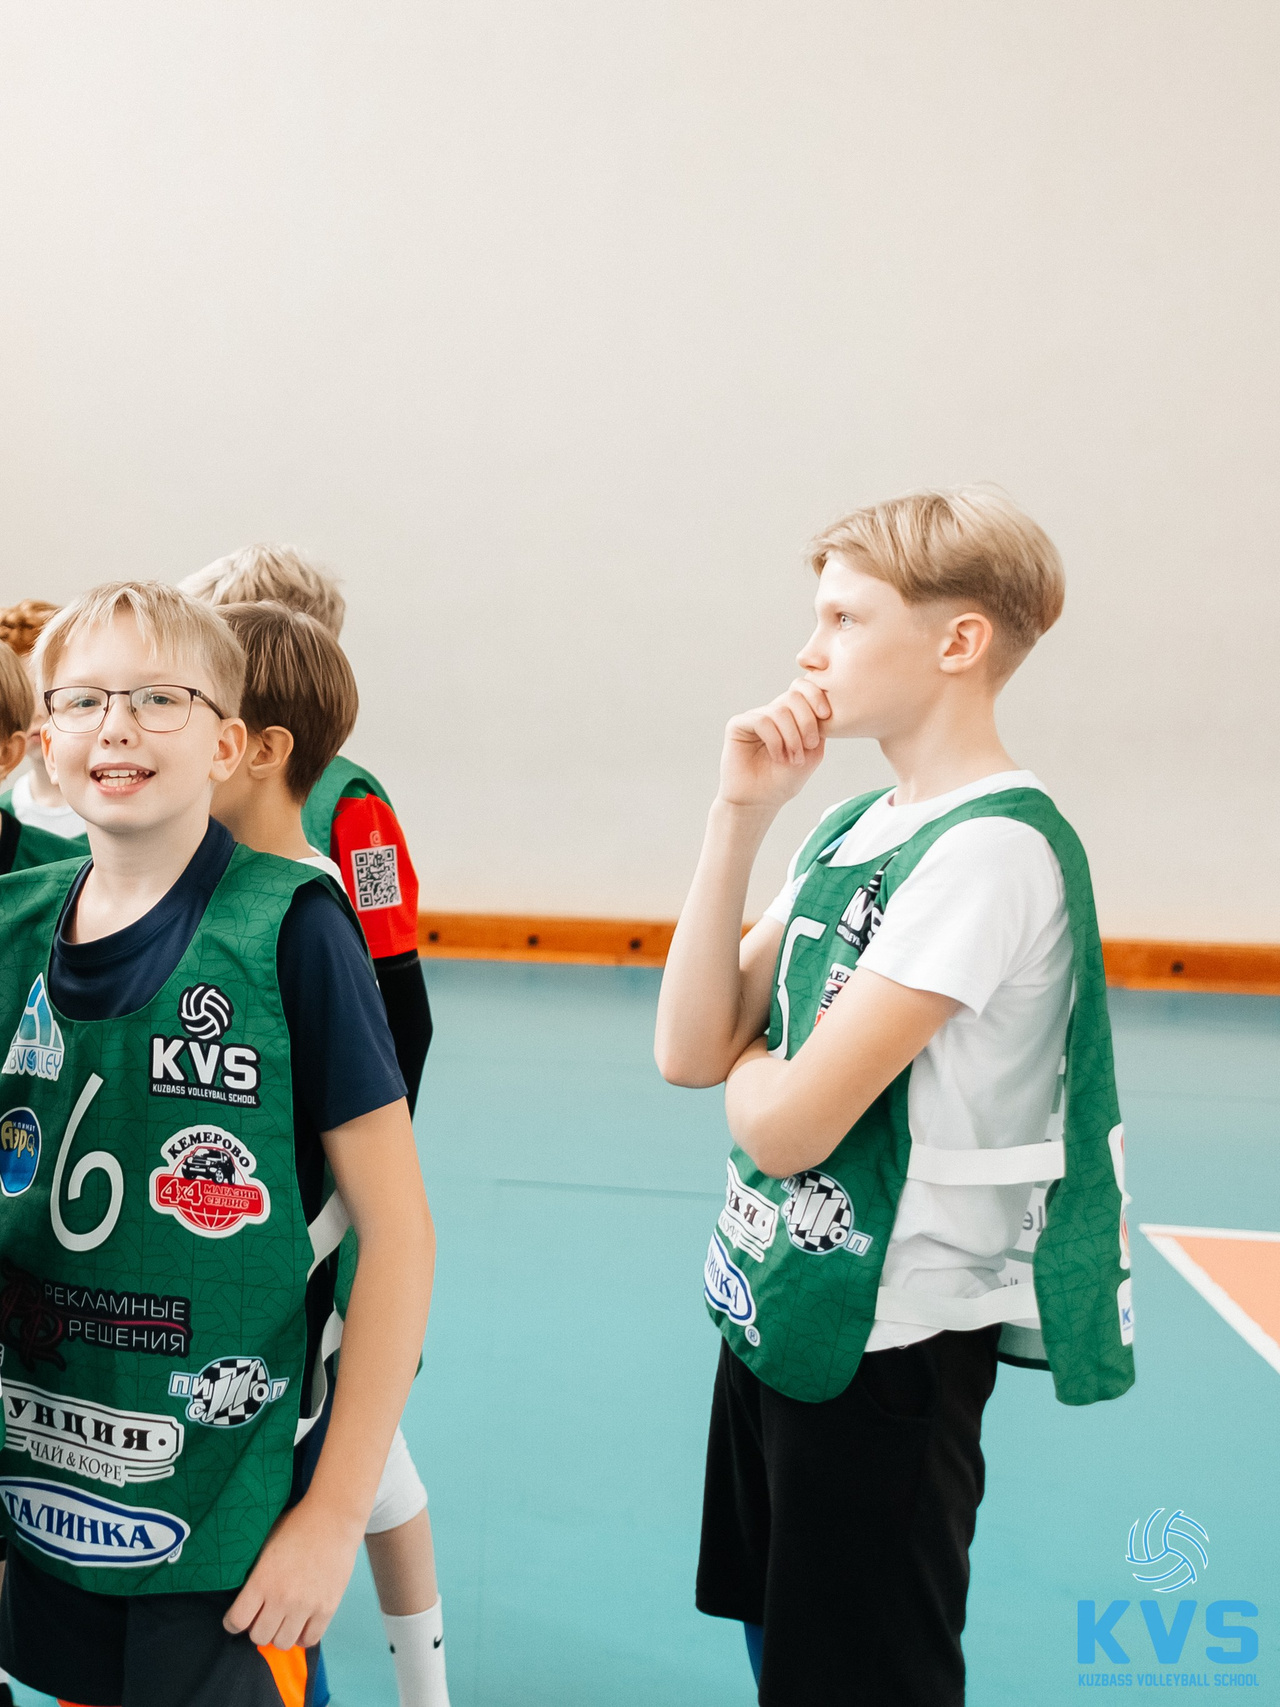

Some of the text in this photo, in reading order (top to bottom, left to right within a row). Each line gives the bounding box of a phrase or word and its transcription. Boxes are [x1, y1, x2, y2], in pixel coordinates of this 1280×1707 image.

[152, 1037, 257, 1090] KVS
[152, 1083, 257, 1105] KUZBASS VOLLEYBALL SCHOOL
[50, 1072, 125, 1252] 6
[167, 1131, 251, 1168] КЕМЕРОВО
[203, 1183, 259, 1200] МАГАЗИН
[203, 1195, 250, 1210] СЕРВИС
[44, 1284, 186, 1321] РЕКЛАМНЫЕ
[68, 1320, 185, 1353] РЕШЕНИЯ
[8, 1395, 152, 1452] УНЦИЯ
[30, 1440, 122, 1482] ЧАЙ & КОФЕ
[4, 1491, 156, 1550] ТАЛИНКА
